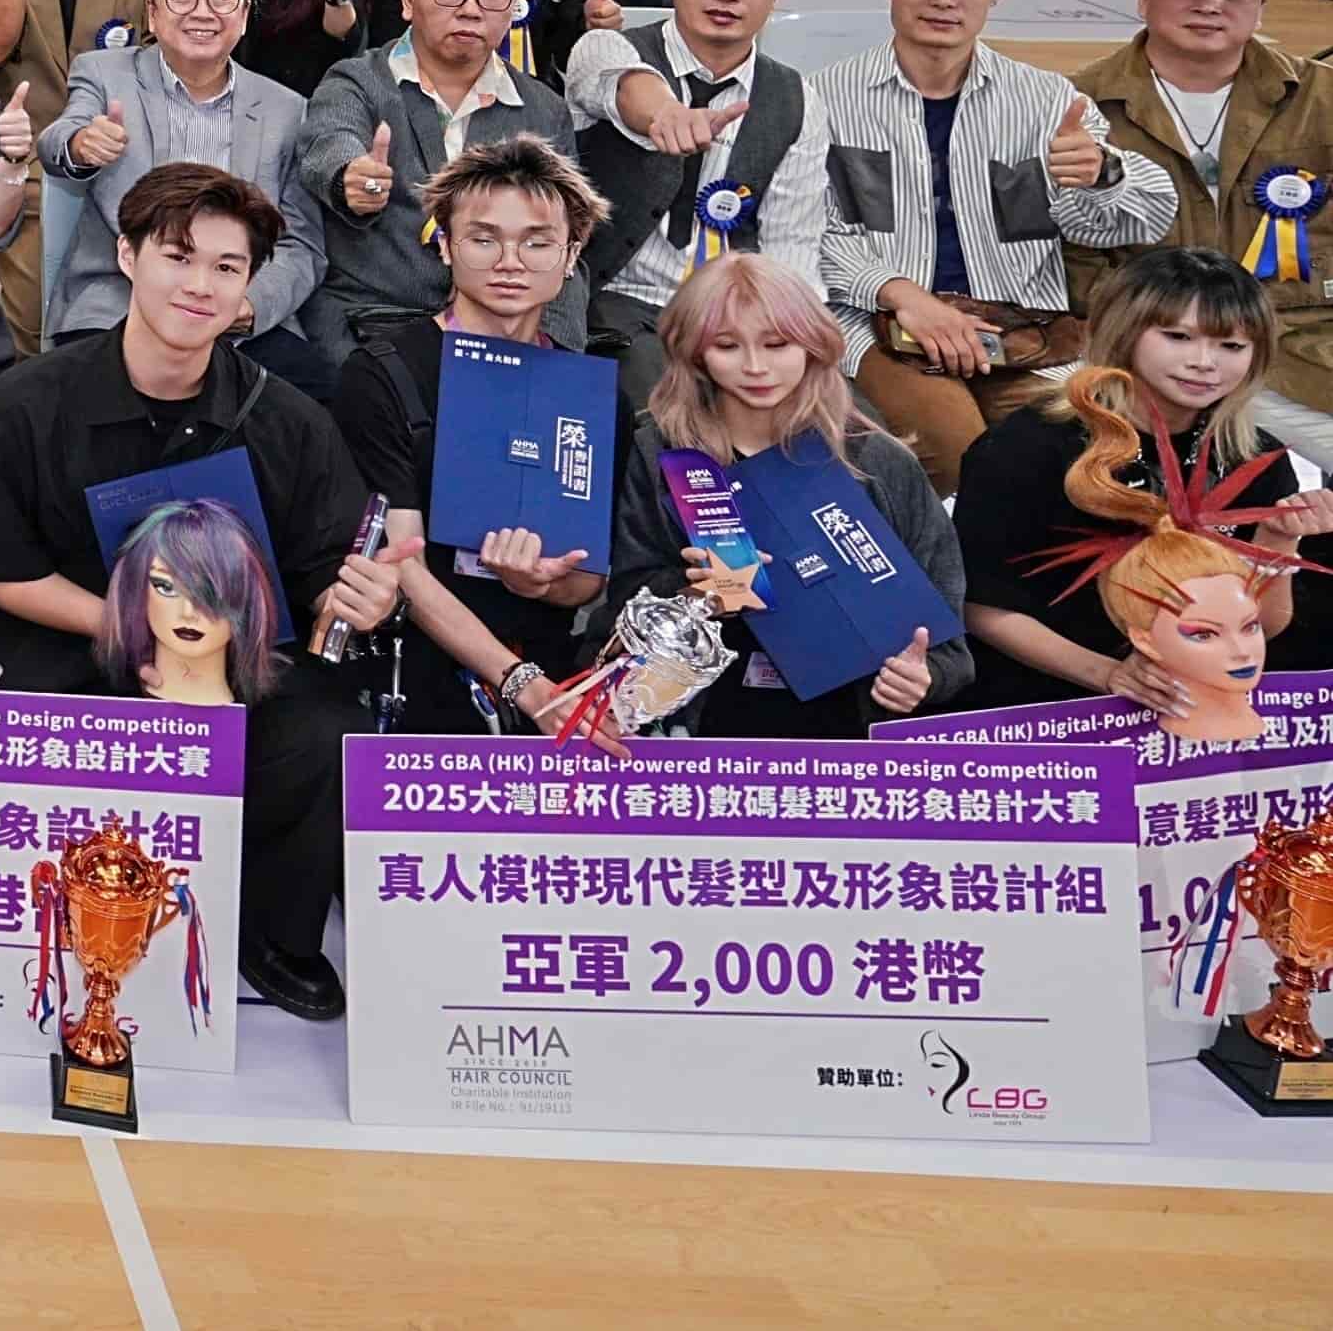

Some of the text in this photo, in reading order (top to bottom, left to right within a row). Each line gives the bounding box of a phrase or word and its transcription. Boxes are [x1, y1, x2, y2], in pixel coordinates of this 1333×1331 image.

[1258, 688, 1313, 709] Image
[7, 710, 75, 731] Design
[81, 714, 210, 737] Competition
[993, 722, 1032, 744] (HK)
[1038, 707, 1158, 739] Digital-Power
[385, 753, 1097, 783] 2025 GBA (HK) Digital-Powered Hair and Image Design Competition
[382, 781, 1100, 825] 2025大灣區杯(香港)數碼髮型及形象設計大賽
[378, 852, 1108, 915] 真人模特現代髮型及形象設計組
[501, 933, 986, 1008] 亞軍 2,000 港幣
[446, 1024, 571, 1058] AHMA
[451, 1070, 573, 1086] HAIR COUNCIL
